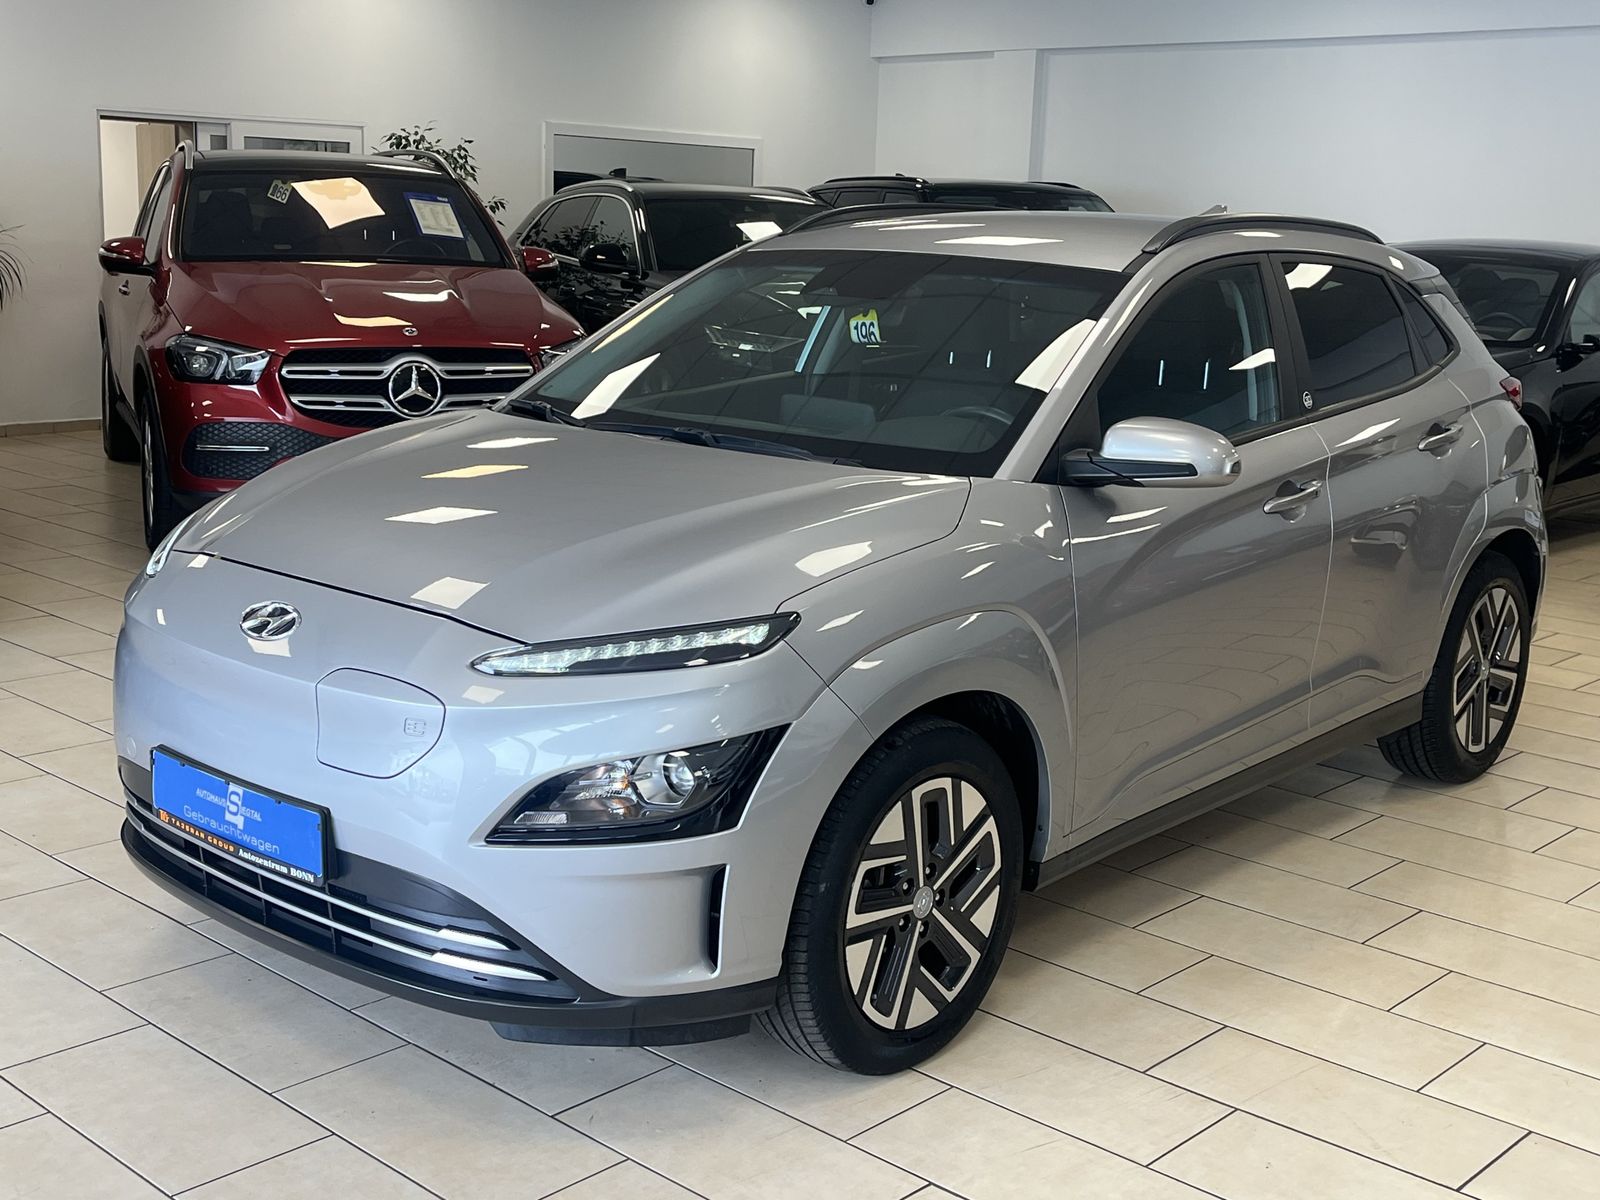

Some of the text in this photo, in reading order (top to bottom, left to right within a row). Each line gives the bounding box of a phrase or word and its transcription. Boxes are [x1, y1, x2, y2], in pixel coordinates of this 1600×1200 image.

[853, 321, 879, 344] 196
[195, 788, 227, 808] AUTOHAUS
[183, 805, 280, 855] Gebrauchtwagen
[207, 835, 235, 853] GROUP
[238, 848, 315, 883] Autozentrum BONN
